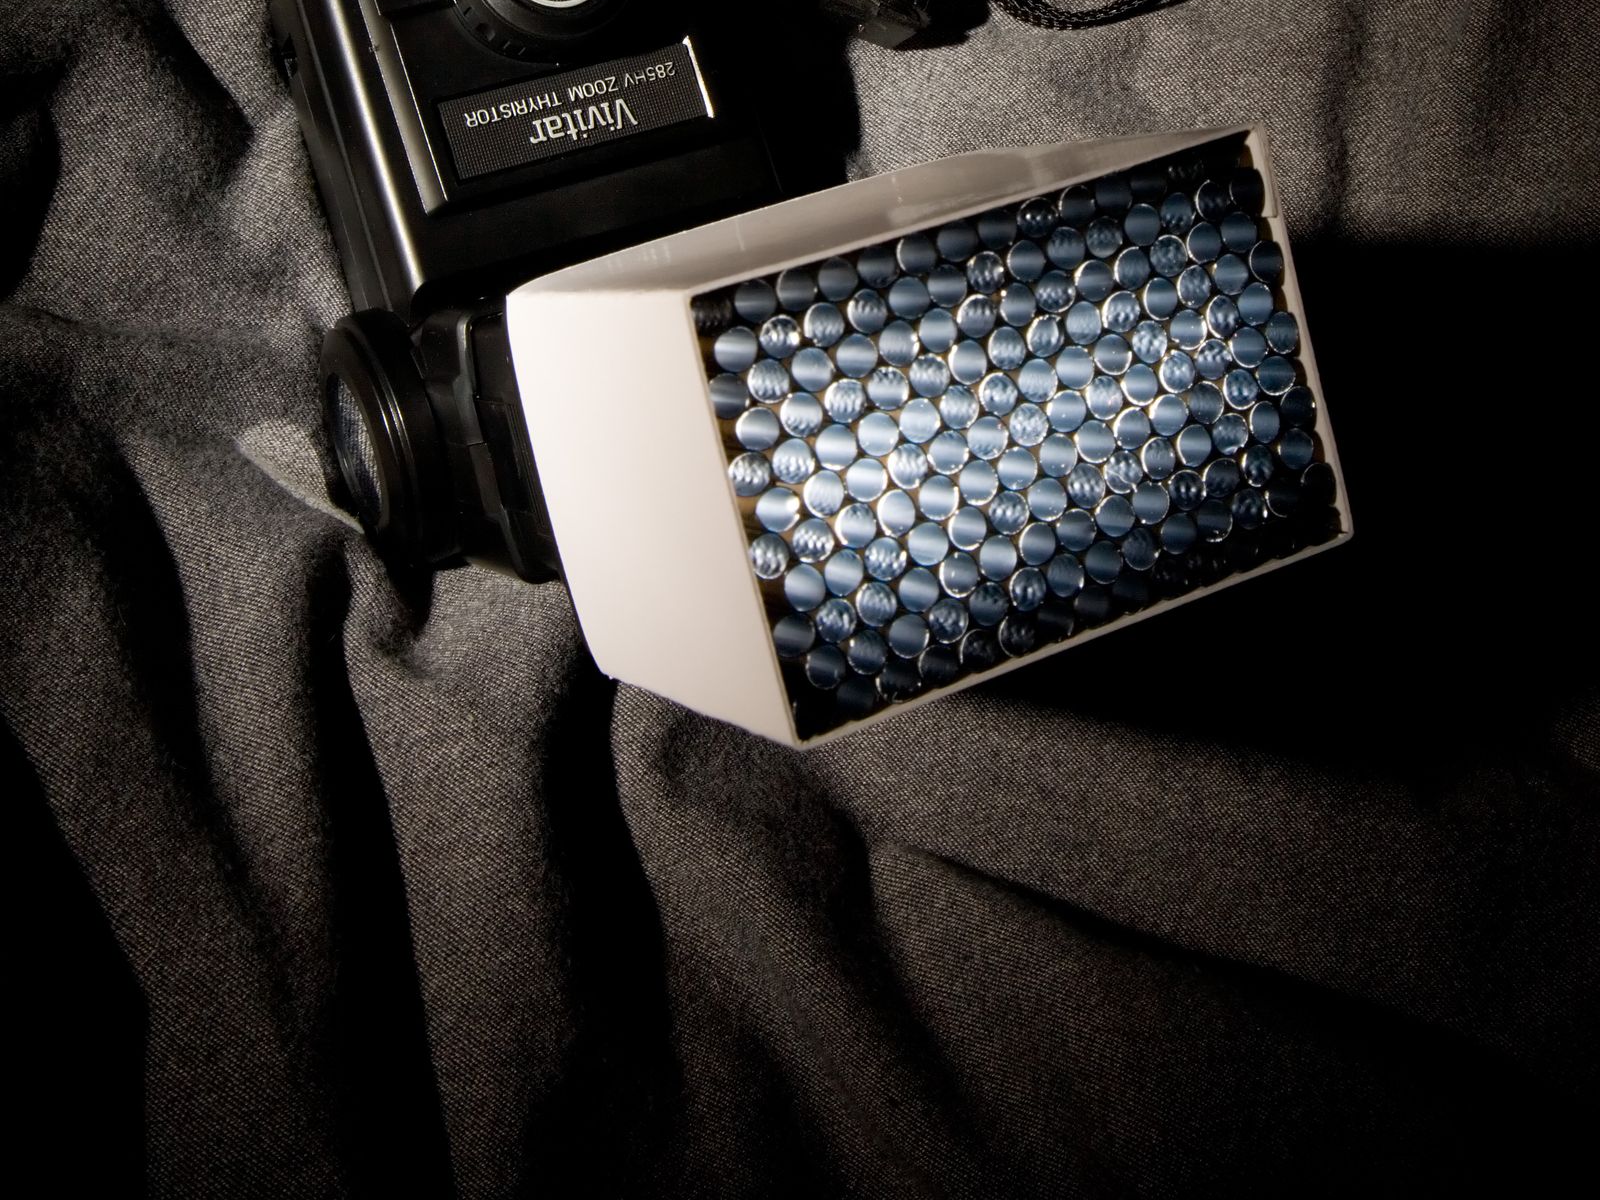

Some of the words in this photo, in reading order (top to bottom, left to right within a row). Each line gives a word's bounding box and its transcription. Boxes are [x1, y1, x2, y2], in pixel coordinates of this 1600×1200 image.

[568, 76, 619, 102] ZOOM
[624, 61, 676, 88] 285HV
[464, 90, 562, 128] THYRISTOR
[529, 98, 639, 144] Vivitar
